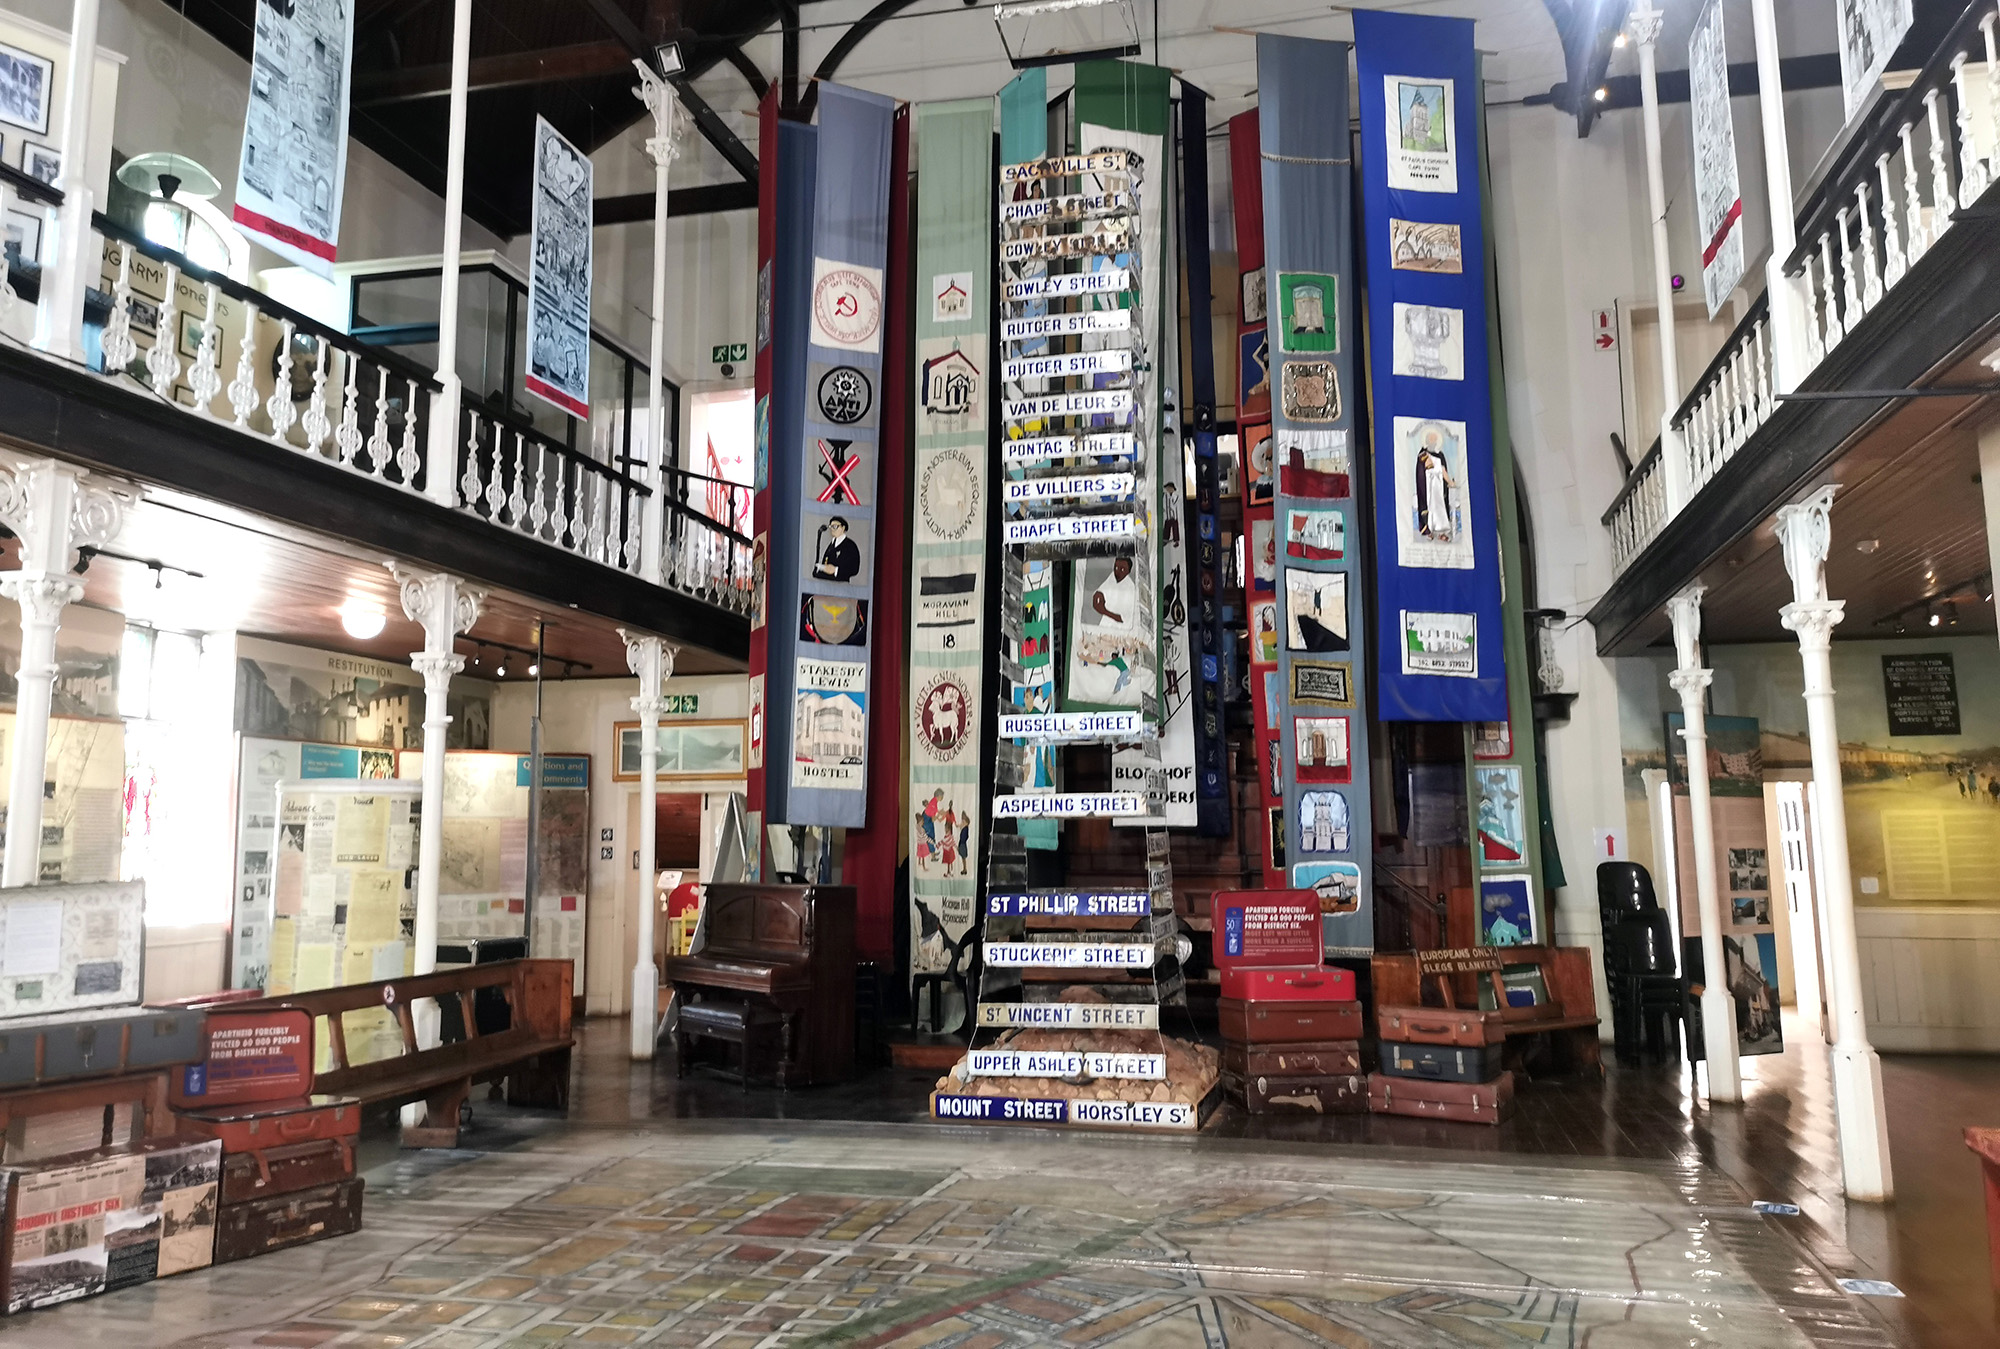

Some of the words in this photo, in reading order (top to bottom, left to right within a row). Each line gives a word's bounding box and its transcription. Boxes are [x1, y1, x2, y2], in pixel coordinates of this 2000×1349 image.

[1006, 158, 1096, 179] SACVILLE
[1006, 200, 1062, 219] CHAPE
[1066, 195, 1120, 212] SREET
[1006, 240, 1062, 258] COWEY
[1006, 280, 1062, 298] COWLEY
[1007, 319, 1061, 336] RUTGER
[1069, 316, 1123, 330] STR
[1008, 360, 1062, 377] RUTGER
[1070, 354, 1126, 370] STRT
[1009, 402, 1036, 416] VAN
[1042, 399, 1060, 413] DE
[1009, 441, 1062, 457] PONTAC
[1070, 437, 1125, 453] STREET
[927, 449, 958, 474] NOSTER
[920, 471, 931, 516] AGNUS
[1011, 484, 1030, 497] DE
[1036, 479, 1105, 495] VILLIERS
[1010, 522, 1066, 539] CHAPEL
[1072, 519, 1128, 534] STREET
[923, 598, 969, 610] MORAVIAN
[936, 609, 958, 618] HILL
[943, 633, 955, 649] 18
[328, 657, 392, 678] RESTITUTION
[800, 664, 864, 677] STAKESBY
[810, 677, 850, 688] LEWIS
[928, 670, 956, 689] AGNUS
[1005, 718, 1070, 733] RUSSELL
[1079, 716, 1135, 731] STREET
[523, 760, 566, 770] Qtions
[567, 762, 583, 770] and
[803, 766, 853, 778] HOSTEL
[1115, 767, 1193, 780] BLOHOF
[543, 776, 583, 784] omments
[1000, 798, 1074, 813] ASPELING
[1081, 797, 1139, 812] STREET
[990, 896, 1010, 913] ST
[1018, 895, 1079, 913] PHILLIP
[1088, 895, 1147, 913] STREET
[1084, 948, 1147, 963] STREET
[1419, 948, 1471, 962] EUROPEANS
[1423, 962, 1453, 973] SLEGS
[1008, 1008, 1072, 1023] VINCENT
[1082, 1009, 1146, 1024] STREET
[212, 1028, 253, 1039] APARTHEID
[255, 1026, 289, 1037] FORCIBLY
[211, 1039, 240, 1049] EVICTED
[273, 1035, 300, 1045] PEOPLE
[211, 1049, 232, 1059] FROM
[235, 1047, 267, 1058] DISTRICT
[974, 1055, 1020, 1071] UPPER
[1028, 1056, 1087, 1073] ASHLEY
[1095, 1058, 1157, 1074] STREET
[939, 1099, 992, 1116] MOUNT
[1003, 1101, 1063, 1119] STREET
[1078, 1103, 1163, 1123] HORSTLEY
